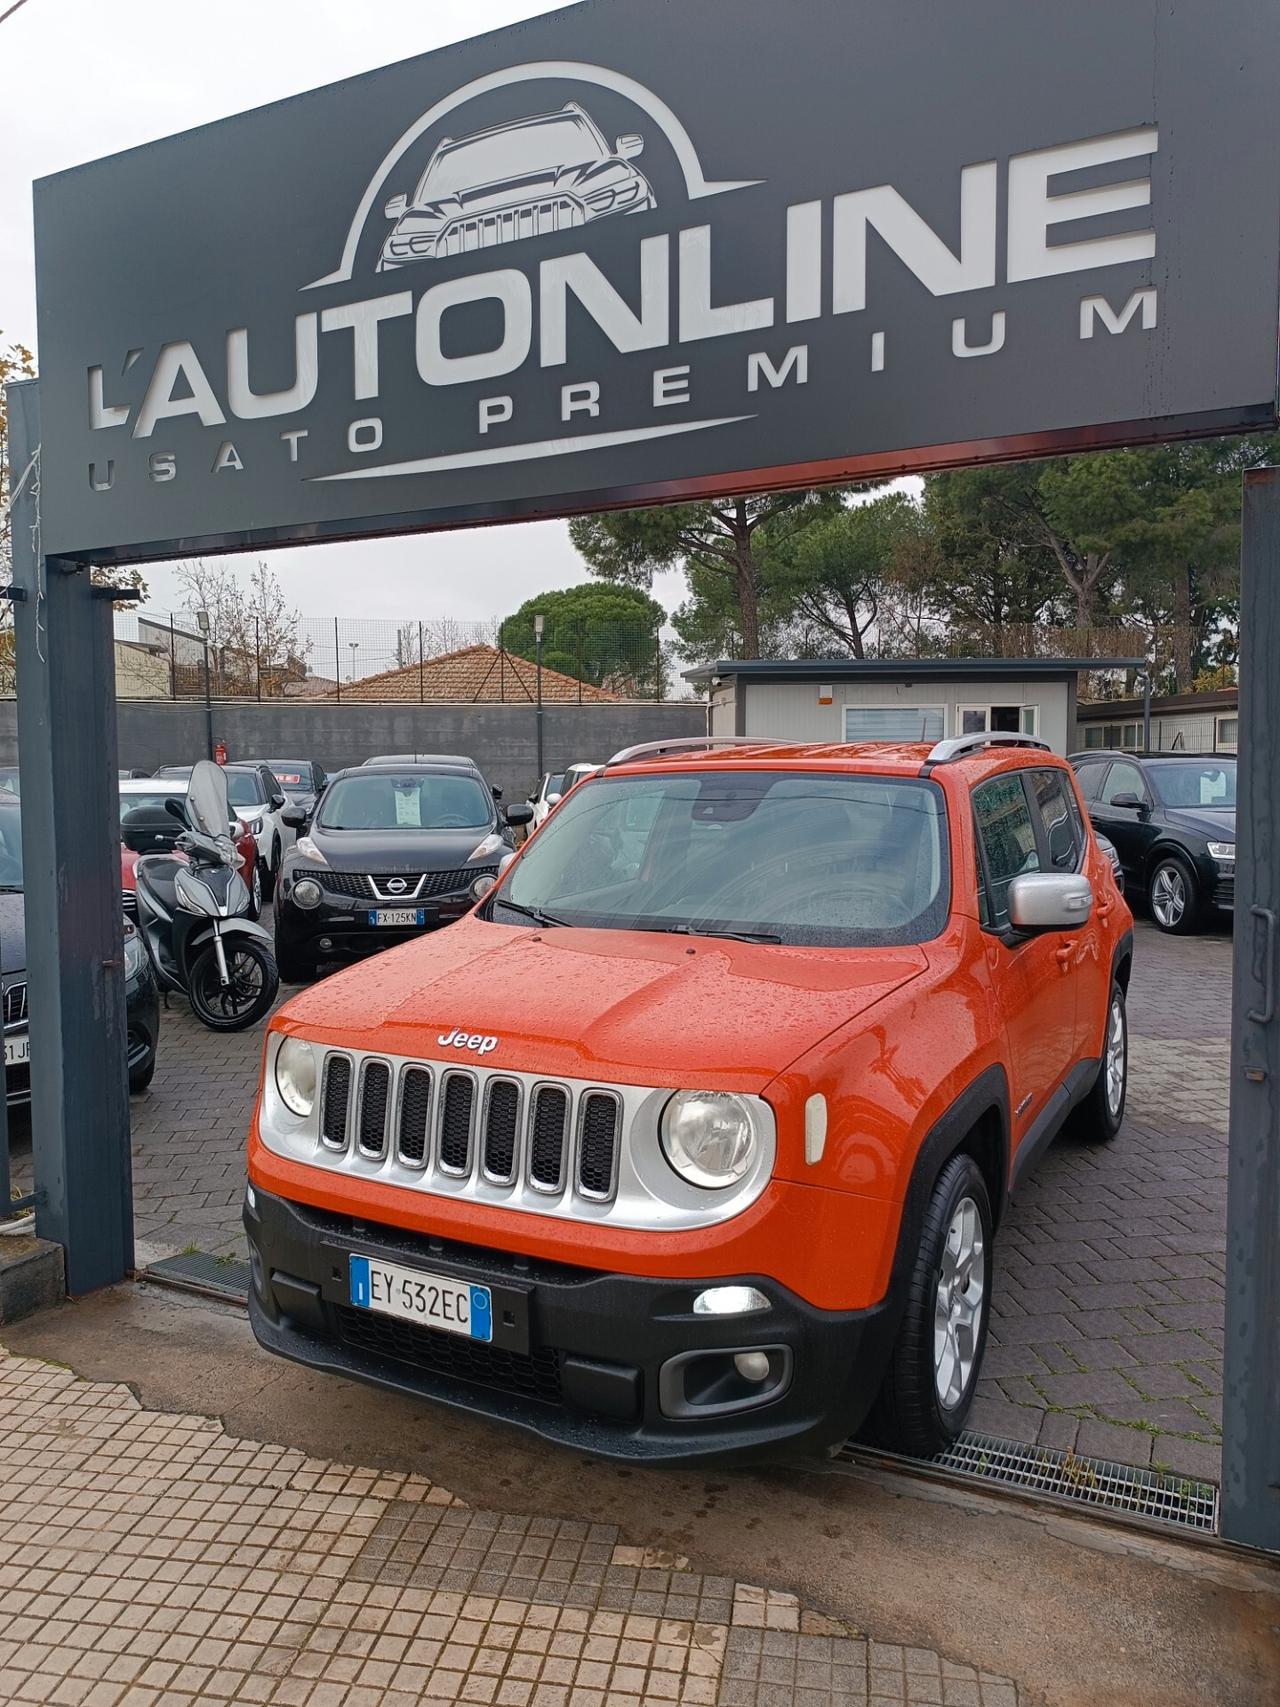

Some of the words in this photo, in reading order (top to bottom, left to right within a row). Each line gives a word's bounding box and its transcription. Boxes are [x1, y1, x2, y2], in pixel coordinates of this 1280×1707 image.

[88, 122, 1159, 440] L'AUTONLINE
[88, 417, 384, 492] USATO
[478, 284, 1158, 434] PREMIUM
[437, 1026, 498, 1056] Jeep
